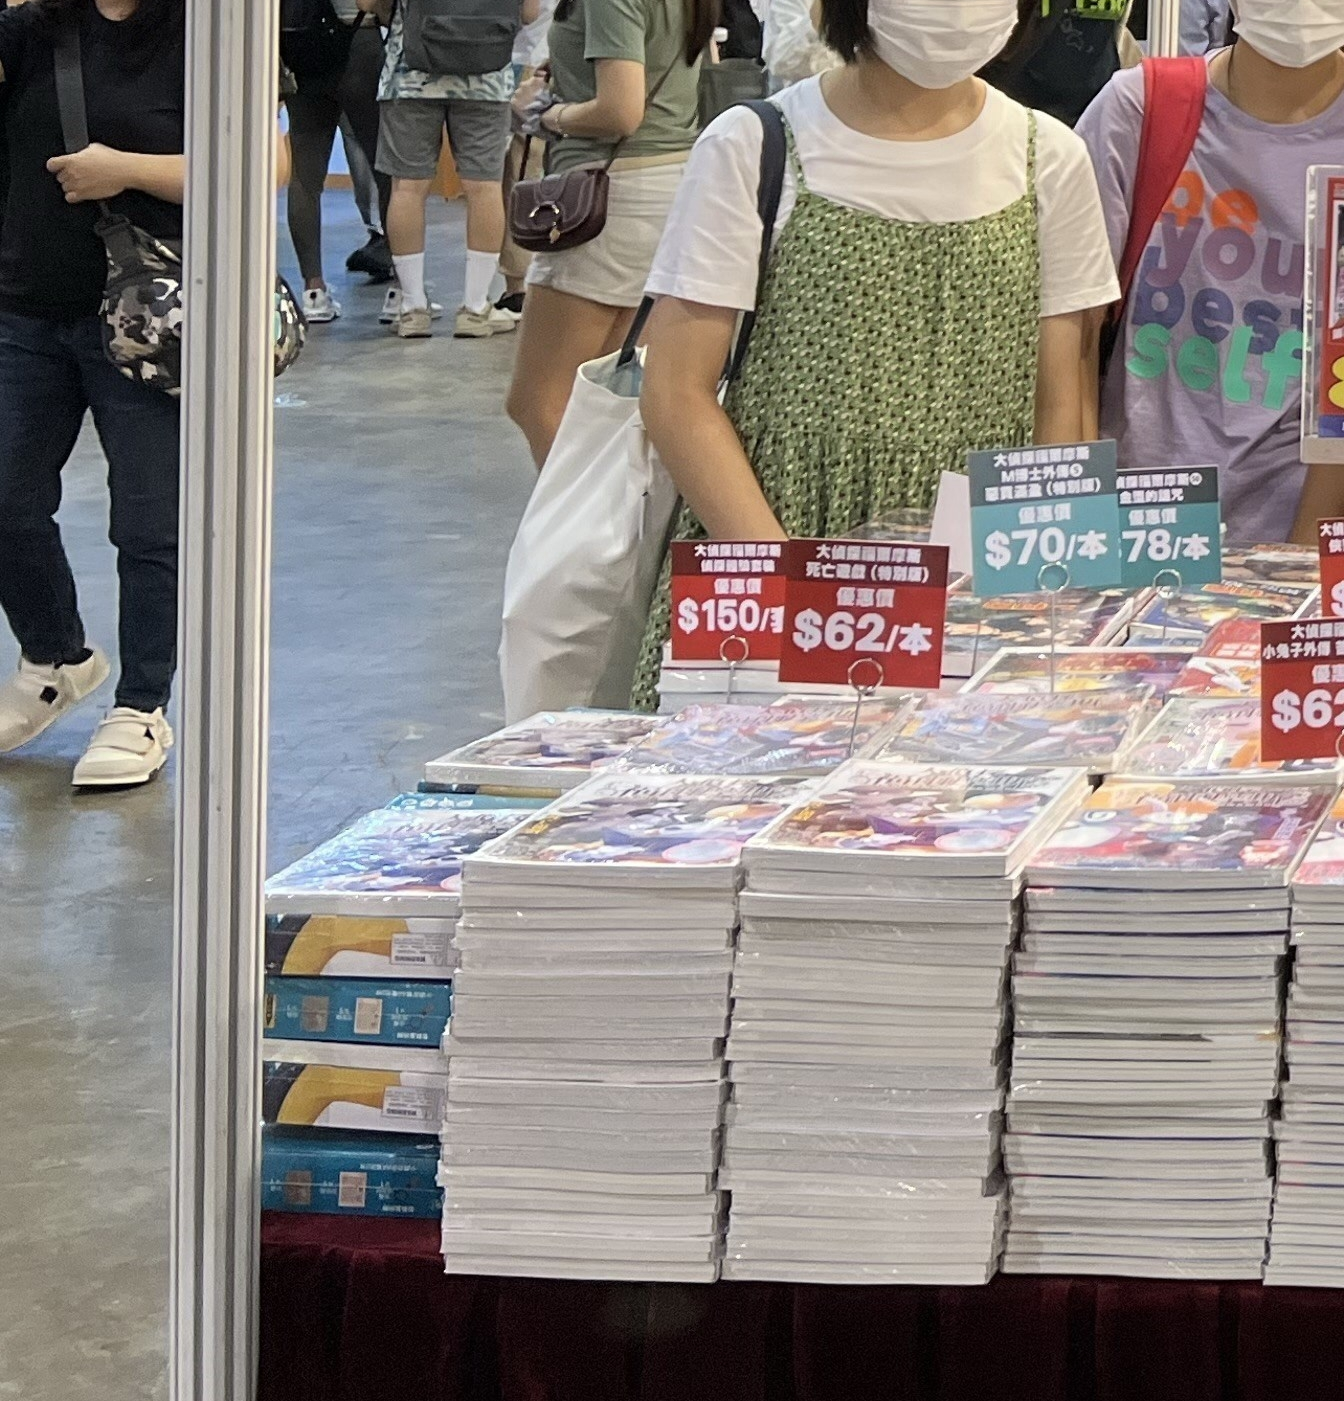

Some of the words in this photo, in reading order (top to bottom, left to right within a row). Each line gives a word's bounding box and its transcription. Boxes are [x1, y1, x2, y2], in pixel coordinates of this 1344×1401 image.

[1125, 322, 1304, 411] self
[1018, 502, 1071, 525] 優惠價
[1128, 507, 1178, 526] 優惠價
[985, 529, 1107, 570] $70/本
[1119, 529, 1210, 565] 78/本
[714, 578, 762, 595] 優惠價
[836, 586, 896, 609] 優惠價
[792, 611, 933, 656] $62/本
